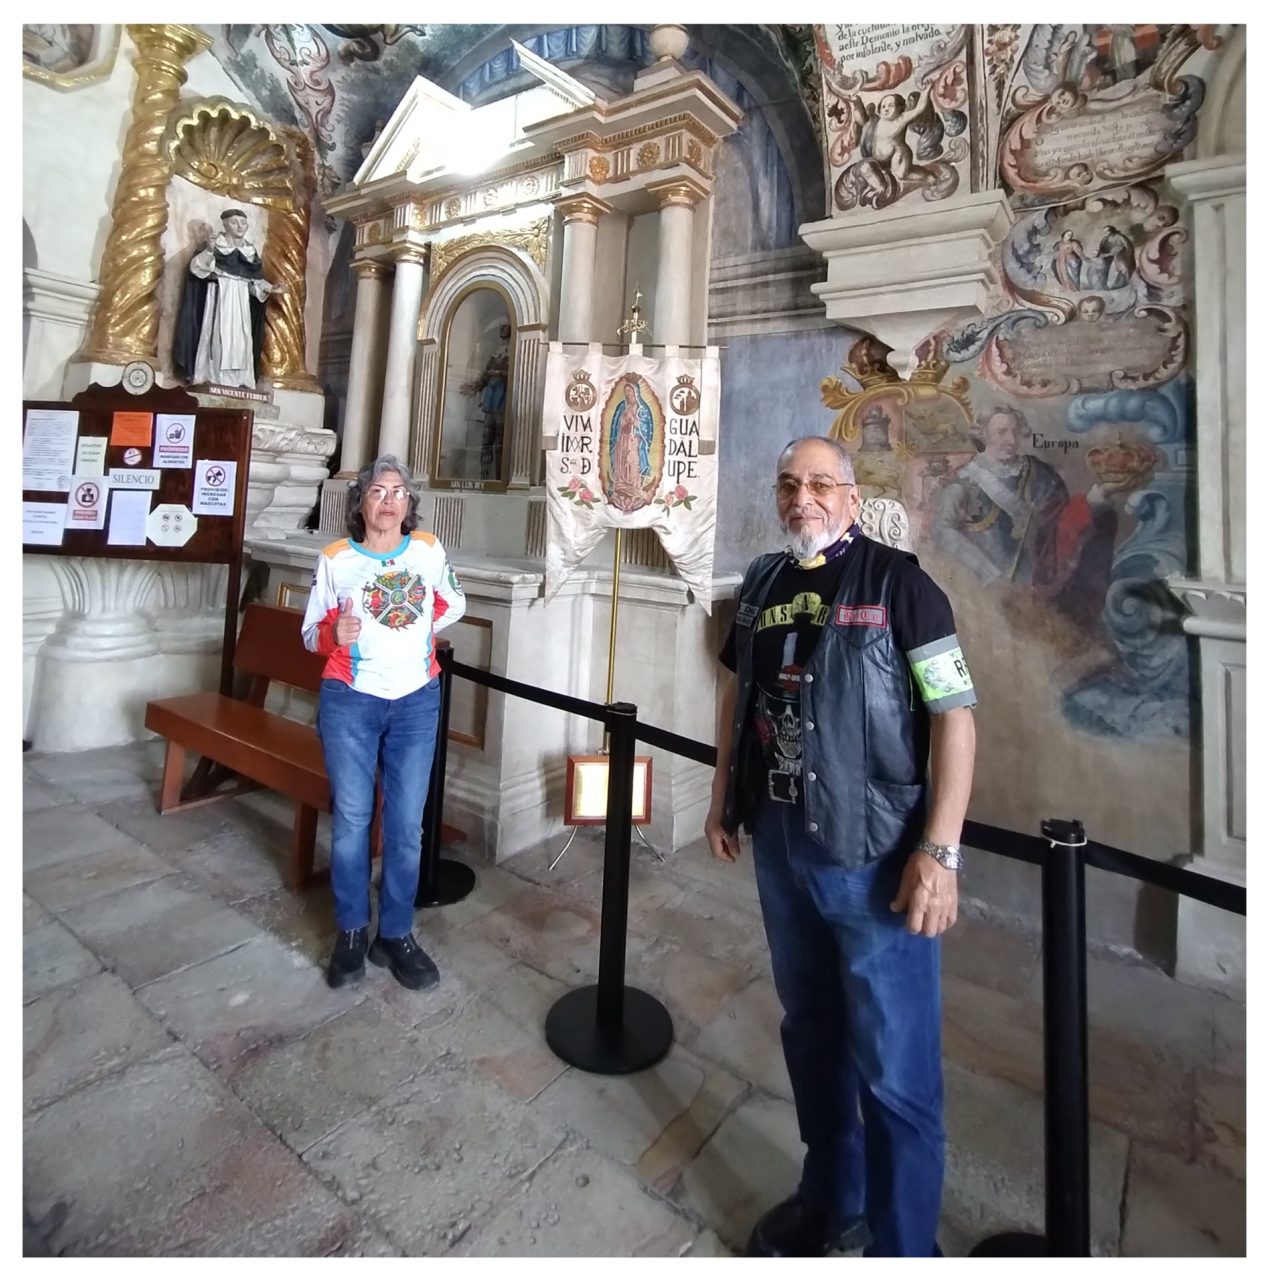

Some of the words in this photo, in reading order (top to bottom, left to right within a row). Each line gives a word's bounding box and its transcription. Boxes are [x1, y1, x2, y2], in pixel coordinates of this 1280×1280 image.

[669, 418, 700, 436] GUA
[668, 439, 698, 458] DAL
[1032, 433, 1080, 454] Europa
[112, 474, 155, 484] SILENCIO
